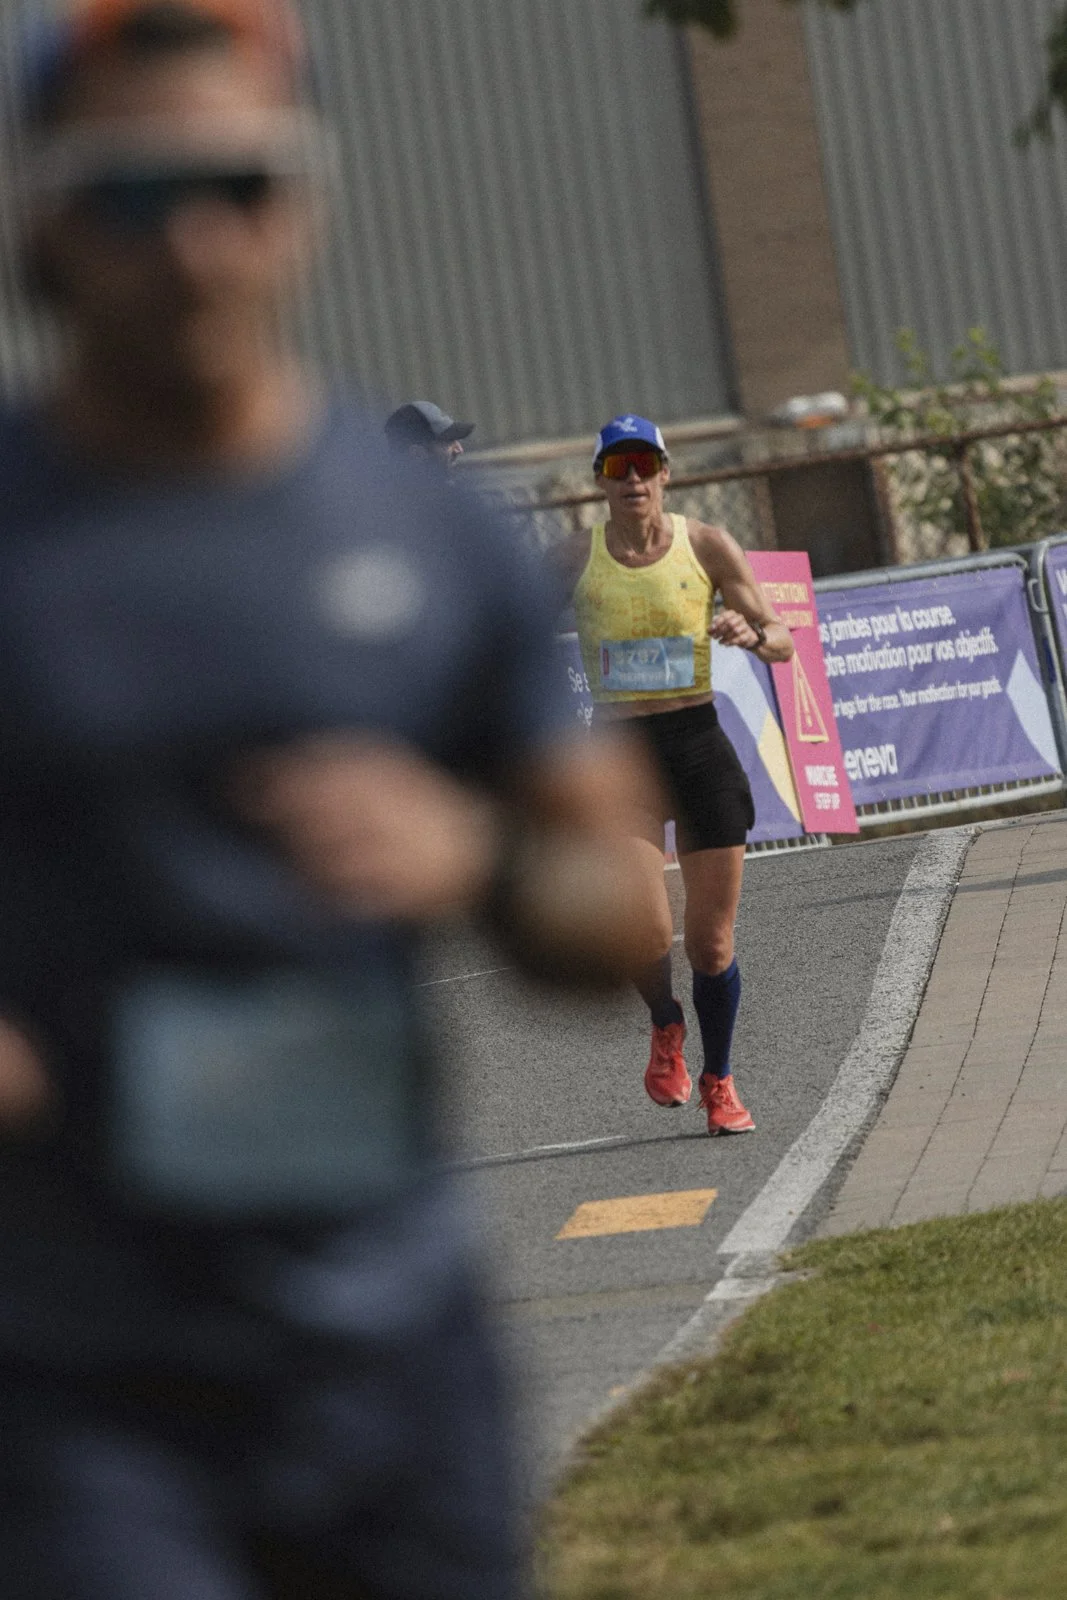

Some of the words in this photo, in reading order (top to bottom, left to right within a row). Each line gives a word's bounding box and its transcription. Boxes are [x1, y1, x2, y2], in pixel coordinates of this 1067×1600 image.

[827, 612, 872, 649] jambes
[870, 613, 899, 642] pour
[895, 604, 915, 633] la
[911, 605, 956, 630] course.
[845, 643, 908, 674] motivation
[906, 641, 935, 673] pour
[934, 639, 956, 663] vos
[844, 744, 898, 780] eneva
